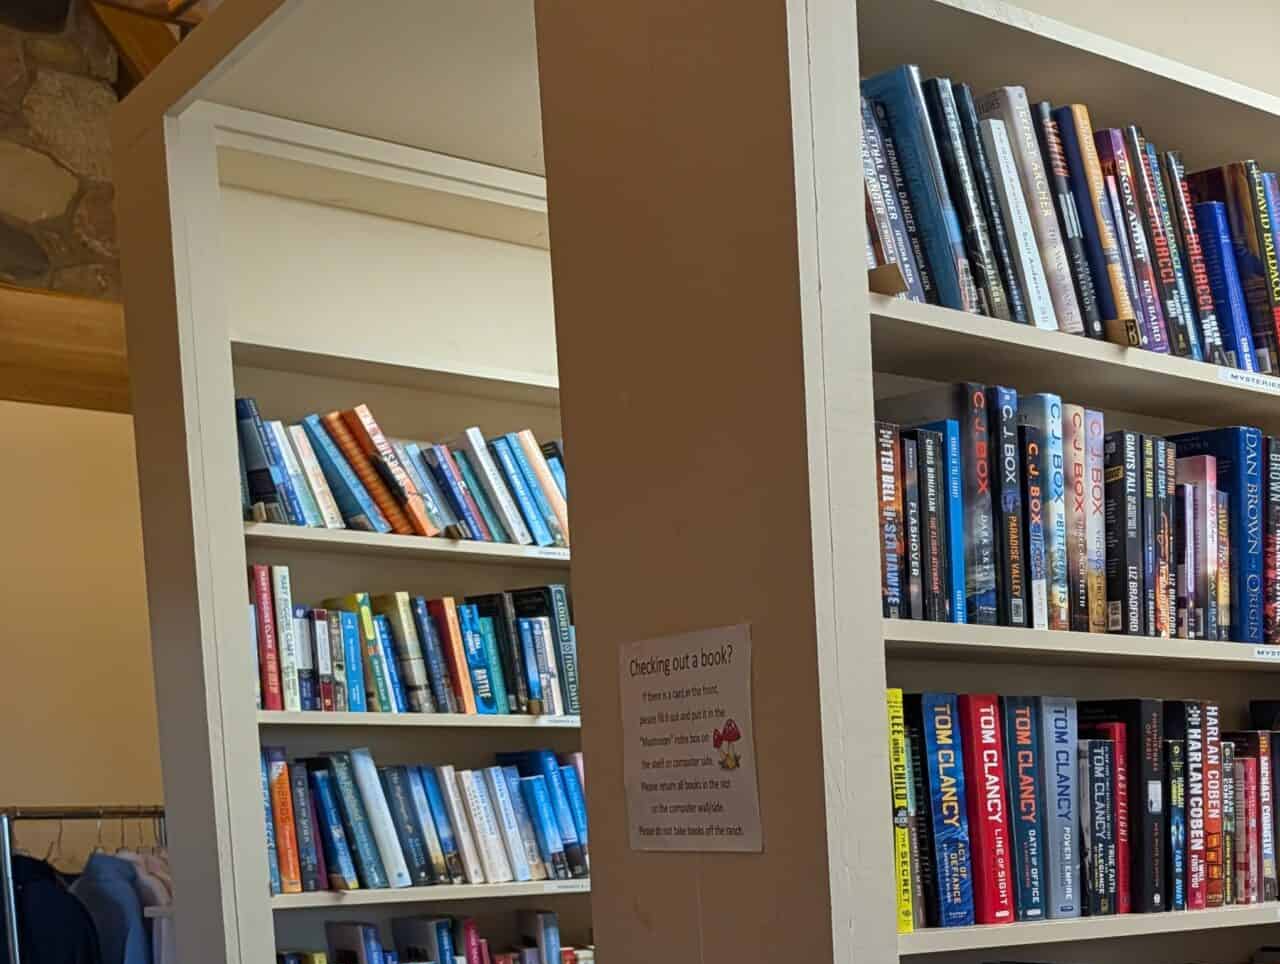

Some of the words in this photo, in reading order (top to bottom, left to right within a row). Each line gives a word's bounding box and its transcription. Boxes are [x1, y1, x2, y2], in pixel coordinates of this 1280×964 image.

[866, 128, 885, 171] LETHAL
[878, 173, 899, 221] DANGER
[1016, 105, 1038, 157] JEFFREY
[1030, 161, 1054, 217] ARCHER
[1115, 148, 1135, 206] YUKON
[1254, 184, 1270, 229] DAVID
[1128, 208, 1147, 263] AUDIT
[1142, 280, 1154, 304] KEN
[1147, 306, 1162, 344] BAIRD
[881, 450, 895, 472] TED
[1004, 439, 1016, 483] BOX
[1126, 434, 1134, 469] GIANTS
[1247, 432, 1258, 476] DAN
[882, 475, 896, 501] BELL
[1127, 472, 1136, 494] FALL
[1270, 454, 1280, 502] BROWN
[909, 502, 920, 576] FLASHOVER
[1008, 515, 1018, 557] PARADISE
[1247, 483, 1259, 554] BROWN
[1011, 561, 1020, 597] VALLEY
[1129, 566, 1137, 580] LIZ
[1129, 582, 1138, 632] BRADFORD
[1247, 574, 1259, 639] ORIGIN
[630, 655, 670, 676] Checking
[673, 655, 690, 671] out
[692, 654, 698, 669] a
[701, 644, 732, 667] book?
[891, 715, 899, 739] LEE
[934, 705, 950, 745] TOM
[978, 705, 994, 744] TOM
[1015, 708, 1031, 745] TOM
[1053, 706, 1068, 745] TOM
[1207, 707, 1218, 764] HARLAN
[893, 760, 907, 801] CHILD
[1189, 729, 1201, 794] HARLAN
[937, 751, 960, 828] CLANCY
[983, 750, 1002, 824] CLANCY
[1018, 751, 1035, 824] CLANCY
[1056, 750, 1071, 821] CLANCY
[1208, 771, 1219, 818] COBEN
[993, 829, 1002, 857] LINE
[1190, 797, 1202, 850] COBEN
[900, 850, 909, 905] SECRET
[997, 873, 1009, 906] SIGHT
